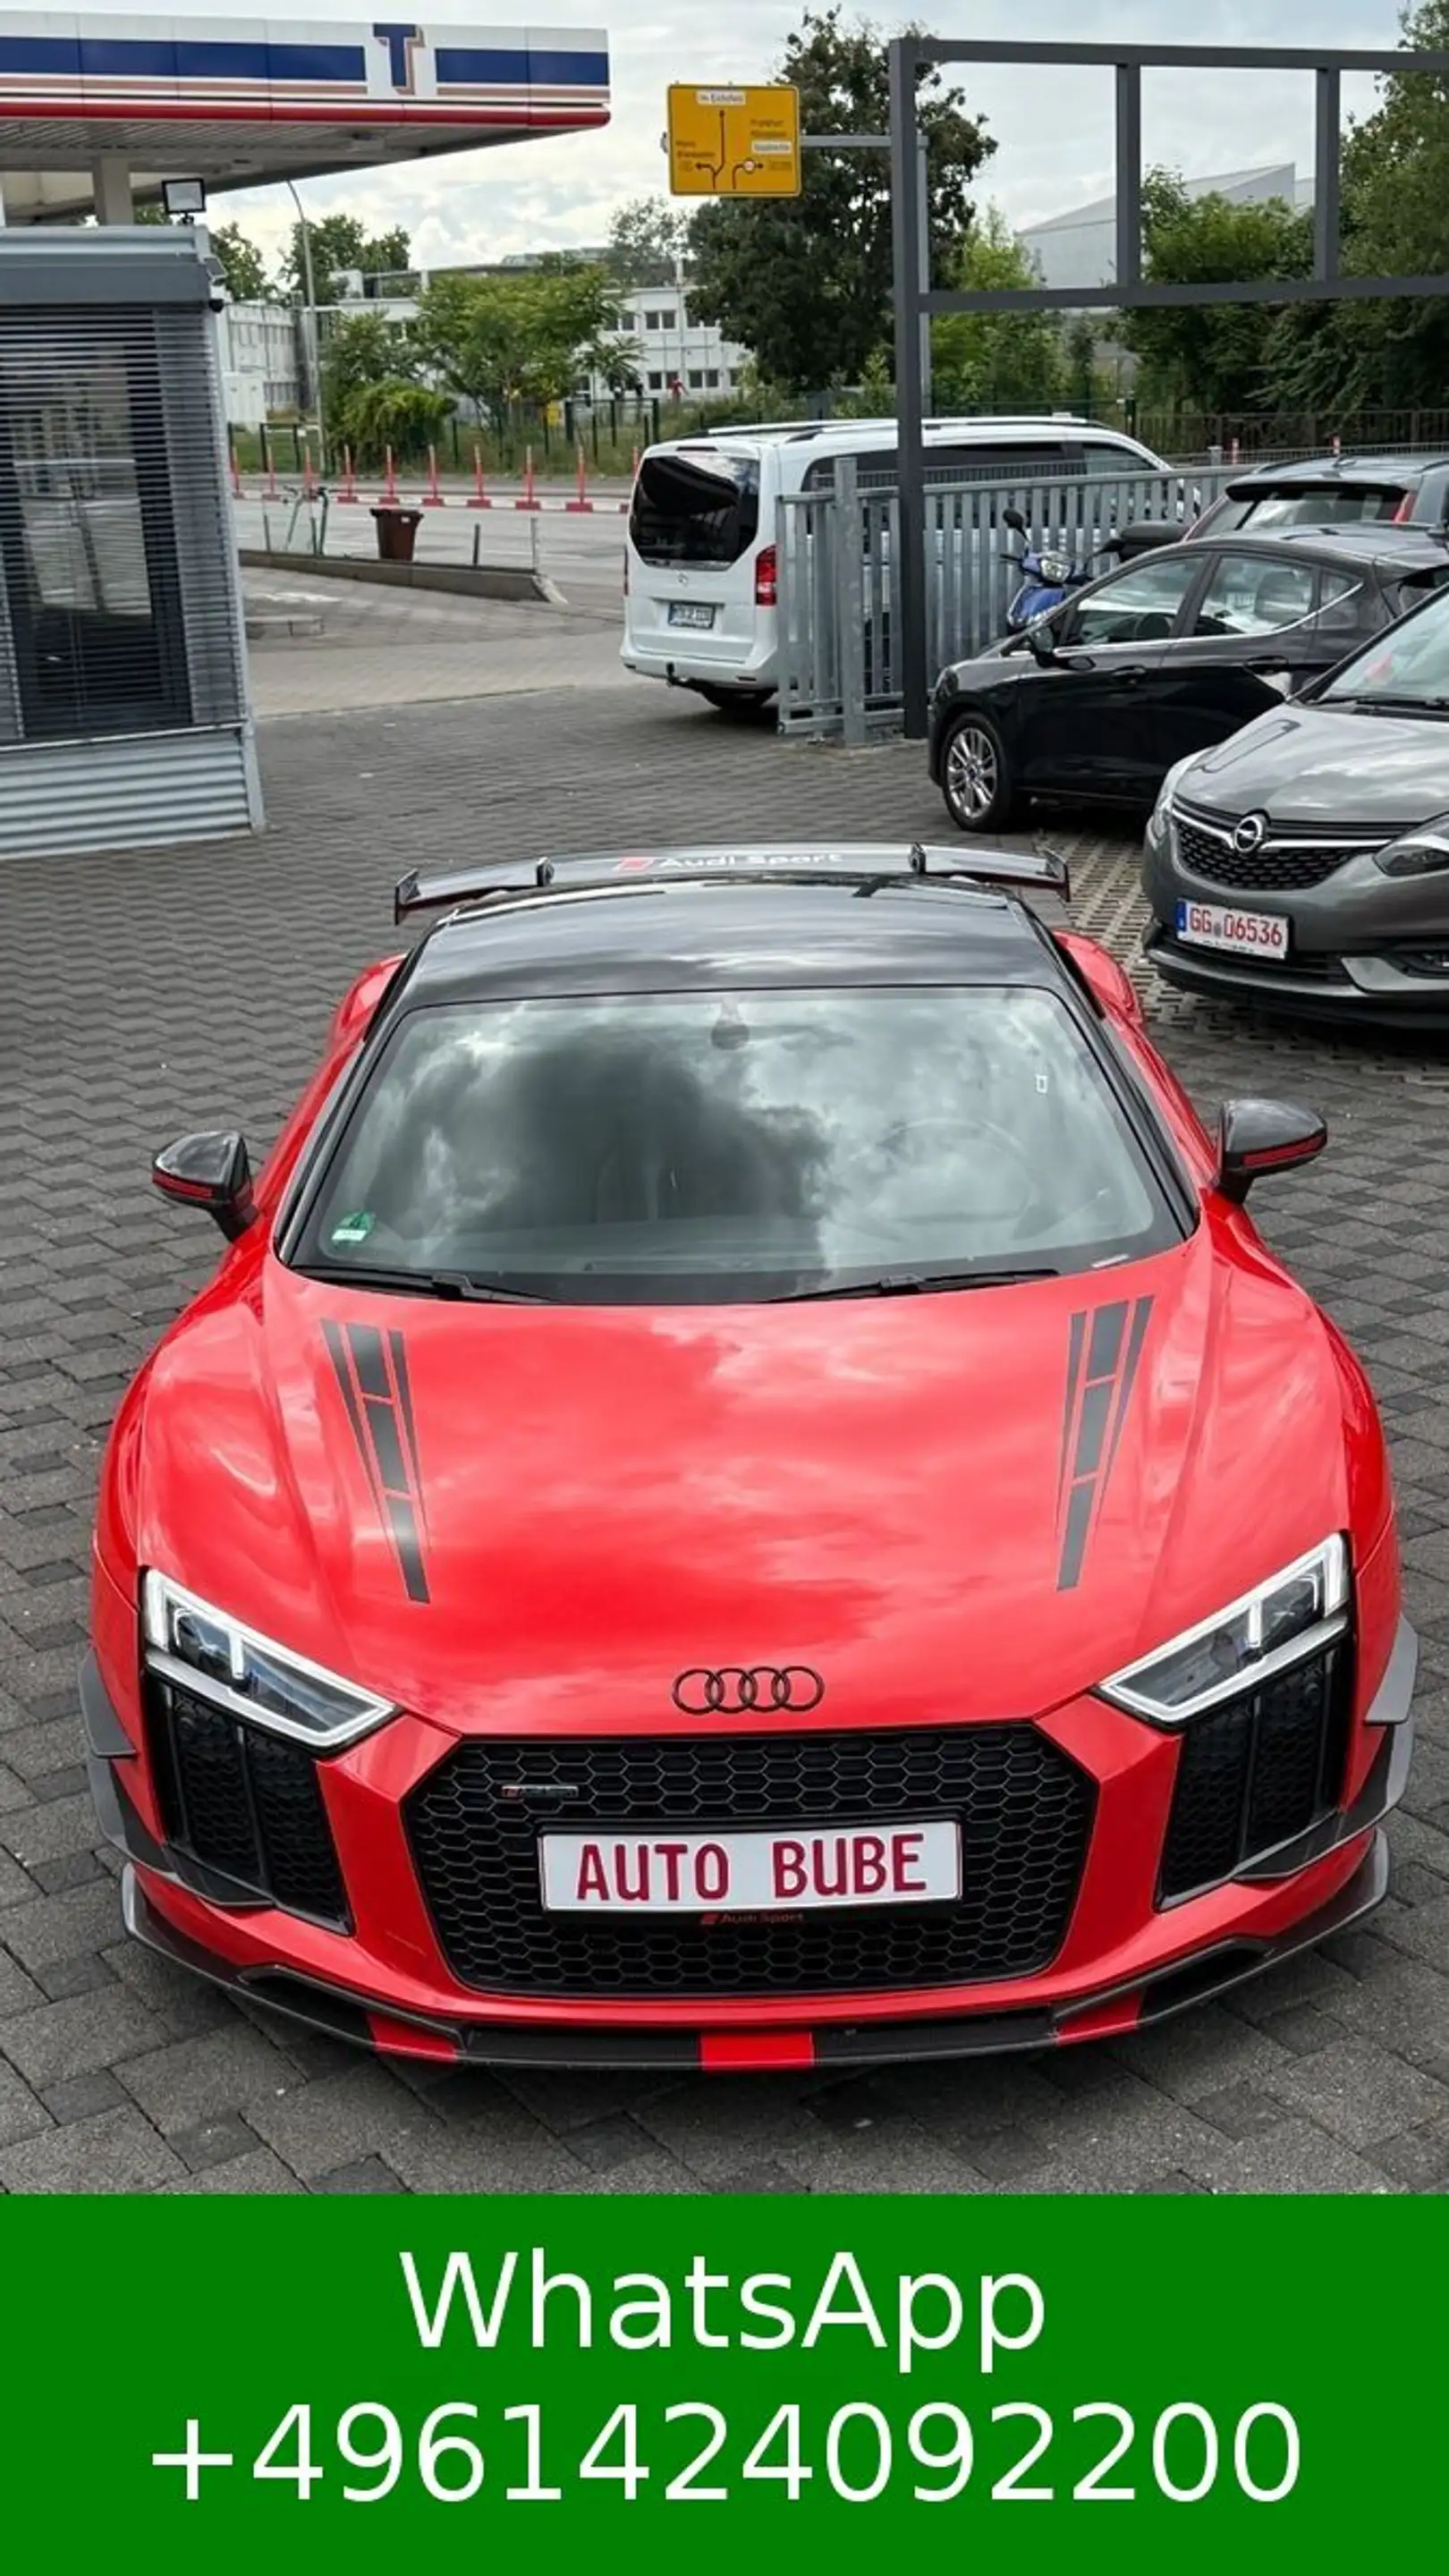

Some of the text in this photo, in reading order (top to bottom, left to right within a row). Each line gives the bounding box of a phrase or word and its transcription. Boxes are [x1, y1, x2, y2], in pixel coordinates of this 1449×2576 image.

[373, 23, 422, 92] T
[659, 853, 843, 869] Audi Sport
[1190, 907, 1213, 933] GG
[1224, 913, 1284, 946] 06536
[577, 1833, 927, 1902] AUTO BUBE
